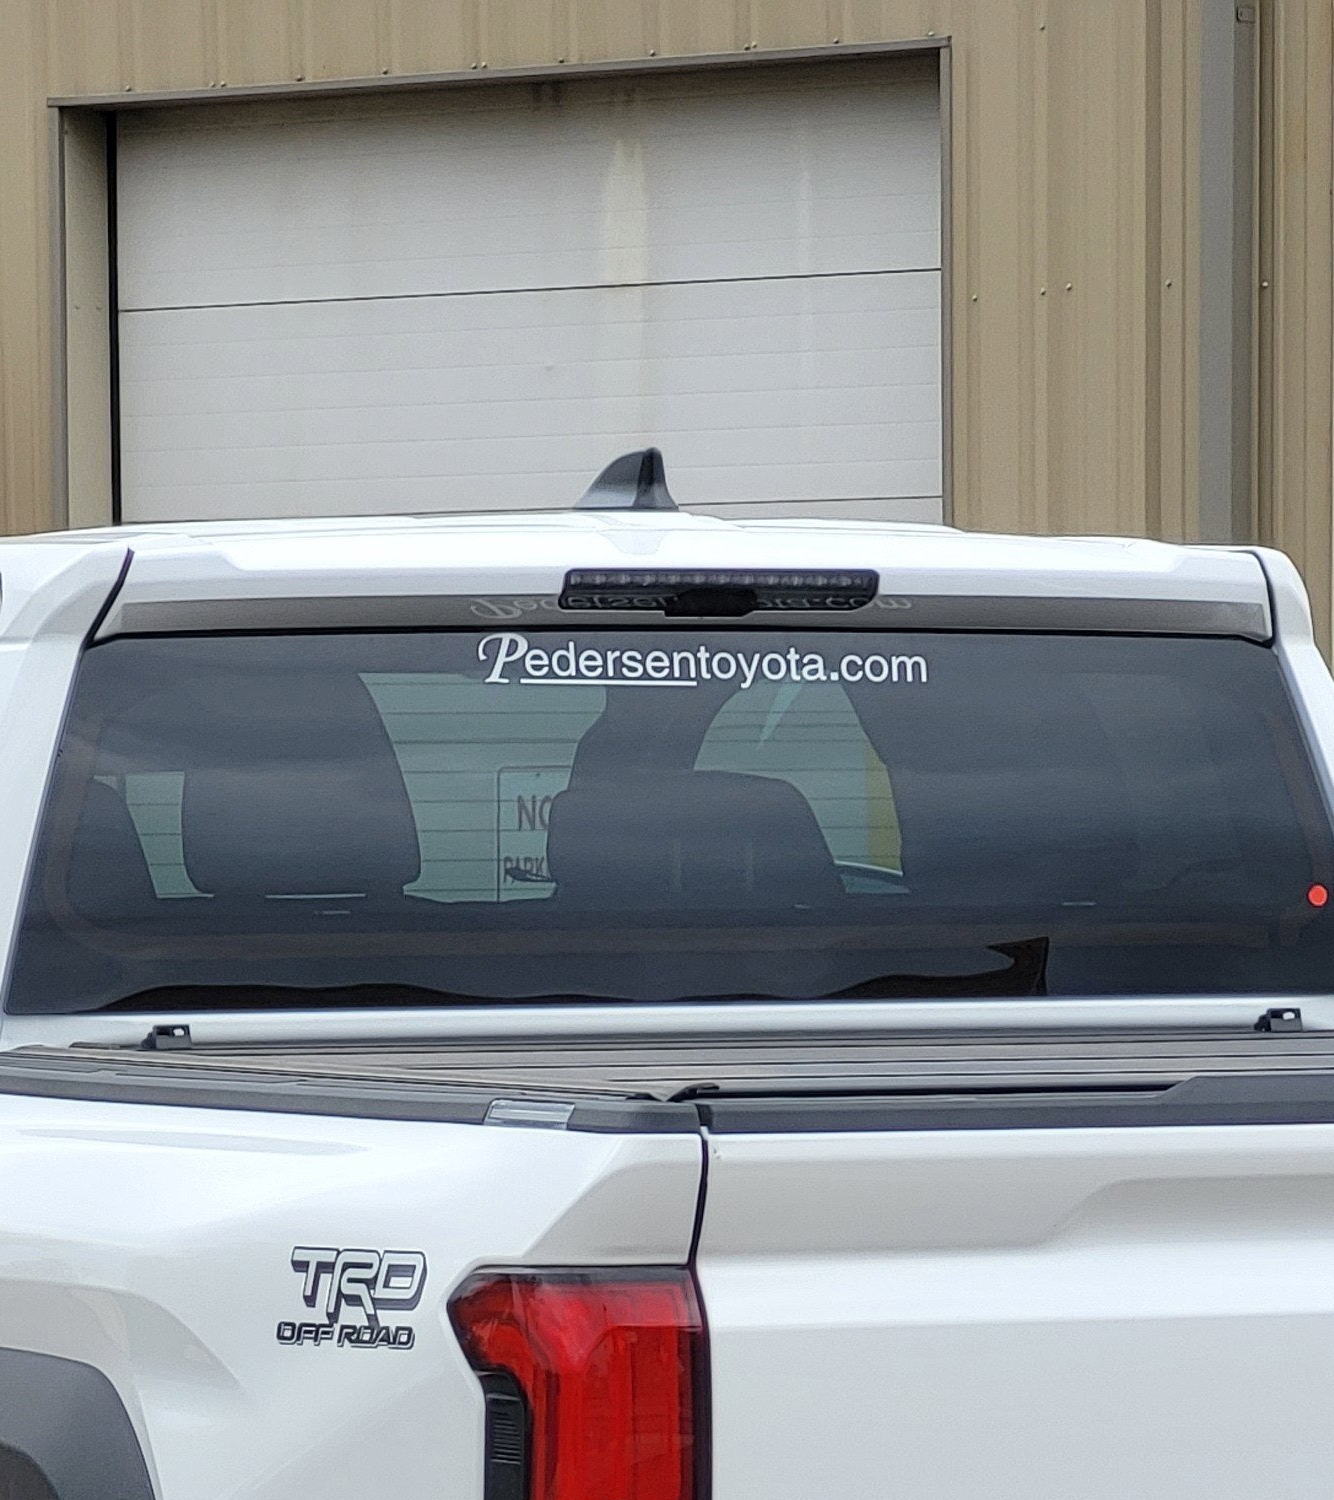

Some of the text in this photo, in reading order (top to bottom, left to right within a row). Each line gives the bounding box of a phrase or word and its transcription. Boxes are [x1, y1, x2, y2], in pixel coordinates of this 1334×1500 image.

[478, 633, 928, 689] Pedersentoyota.com
[291, 1246, 427, 1328] TRD
[276, 1321, 415, 1350] OFF ROAD
